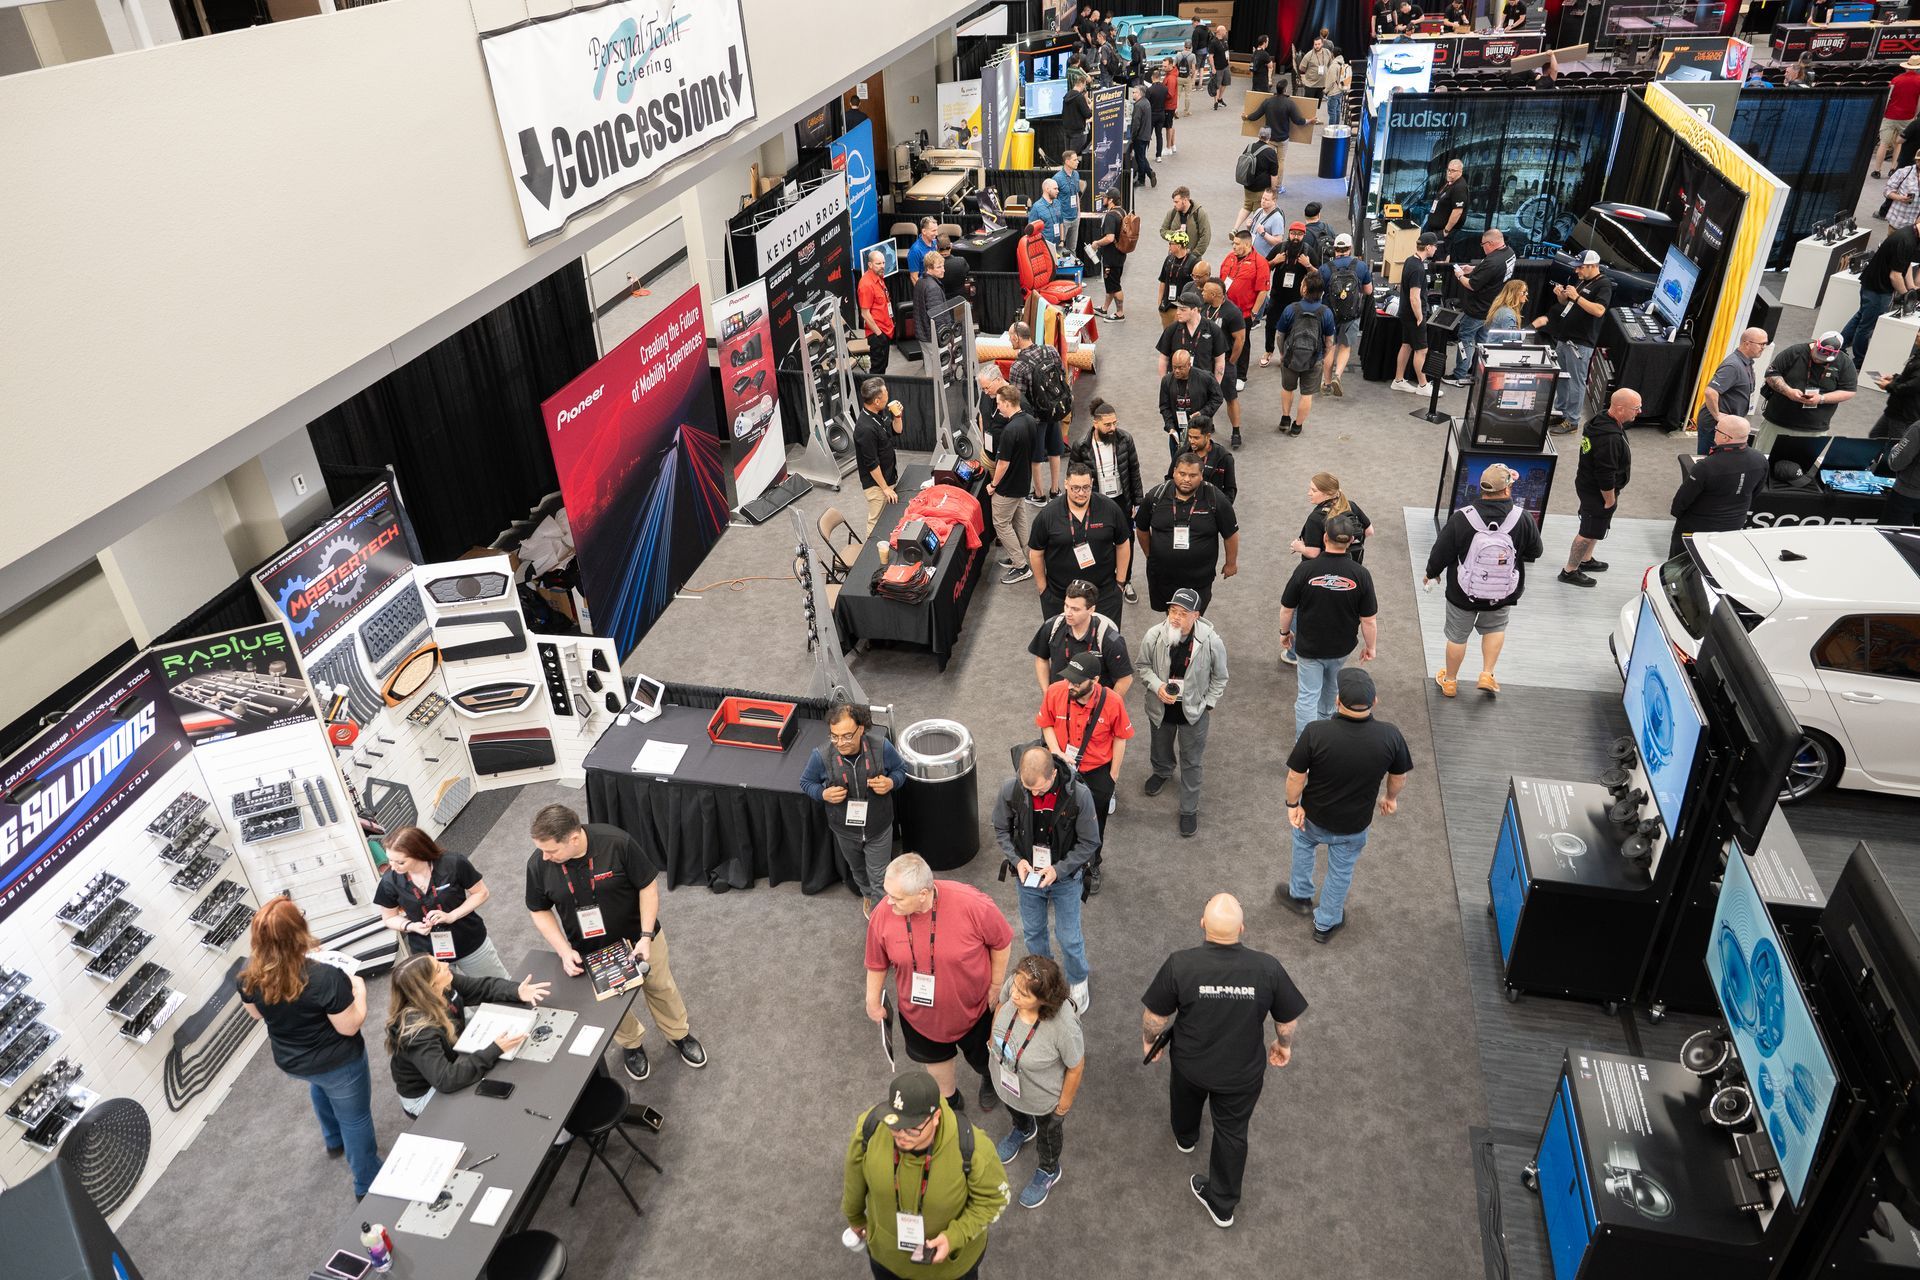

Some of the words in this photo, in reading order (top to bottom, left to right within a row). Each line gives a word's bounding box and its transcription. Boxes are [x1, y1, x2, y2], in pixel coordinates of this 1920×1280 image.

[589, 14, 645, 71] Personal
[645, 5, 681, 51] Touch
[1486, 46, 1503, 57] BUILD
[1503, 46, 1516, 56] OFF
[1812, 39, 1833, 50] BUILD
[1833, 38, 1845, 49] OFF
[1878, 39, 1920, 52] EX
[617, 57, 672, 87] Catering
[551, 70, 731, 200] Concessions
[1390, 110, 1468, 128] audison
[766, 218, 811, 264] KEYSTON
[816, 198, 841, 226] BROS
[820, 224, 841, 247] ALCANTARA
[640, 330, 669, 365] Creating
[668, 323, 680, 341] the
[679, 306, 700, 333] Future
[631, 383, 641, 403] of
[640, 362, 666, 396] Mobility
[665, 331, 703, 374] Experiences
[556, 384, 605, 431] Pioneer
[347, 502, 364, 517] SMART
[363, 485, 389, 506] SOLUTIONS
[308, 530, 326, 546] SMART
[325, 518, 343, 533] TOOLS
[1741, 511, 1879, 530] SCO
[258, 565, 278, 581] SMART
[278, 548, 303, 566] TRAINING
[290, 523, 400, 617] MASTERTECH
[953, 548, 977, 604] Pionee
[310, 563, 368, 611] CERTIFIED
[302, 563, 413, 656] W.MOBILESOLUTIONS-USA.COM
[162, 631, 285, 670] RADIUS
[167, 661, 214, 679] FIT
[241, 645, 286, 661] KIT
[127, 668, 151, 688] TOOLS
[267, 715, 316, 729] INNOVATION
[273, 714, 307, 725] DRIVING
[5, 732, 69, 787] CRAFTSMANSHIP
[0, 815, 19, 868] E
[20, 700, 156, 848] SOLUTIONS
[0, 770, 150, 908] OBILESOLUTIONS-USA.COM
[1199, 985, 1256, 996] SELF-MADE
[1638, 1064, 1650, 1082] LIVE
